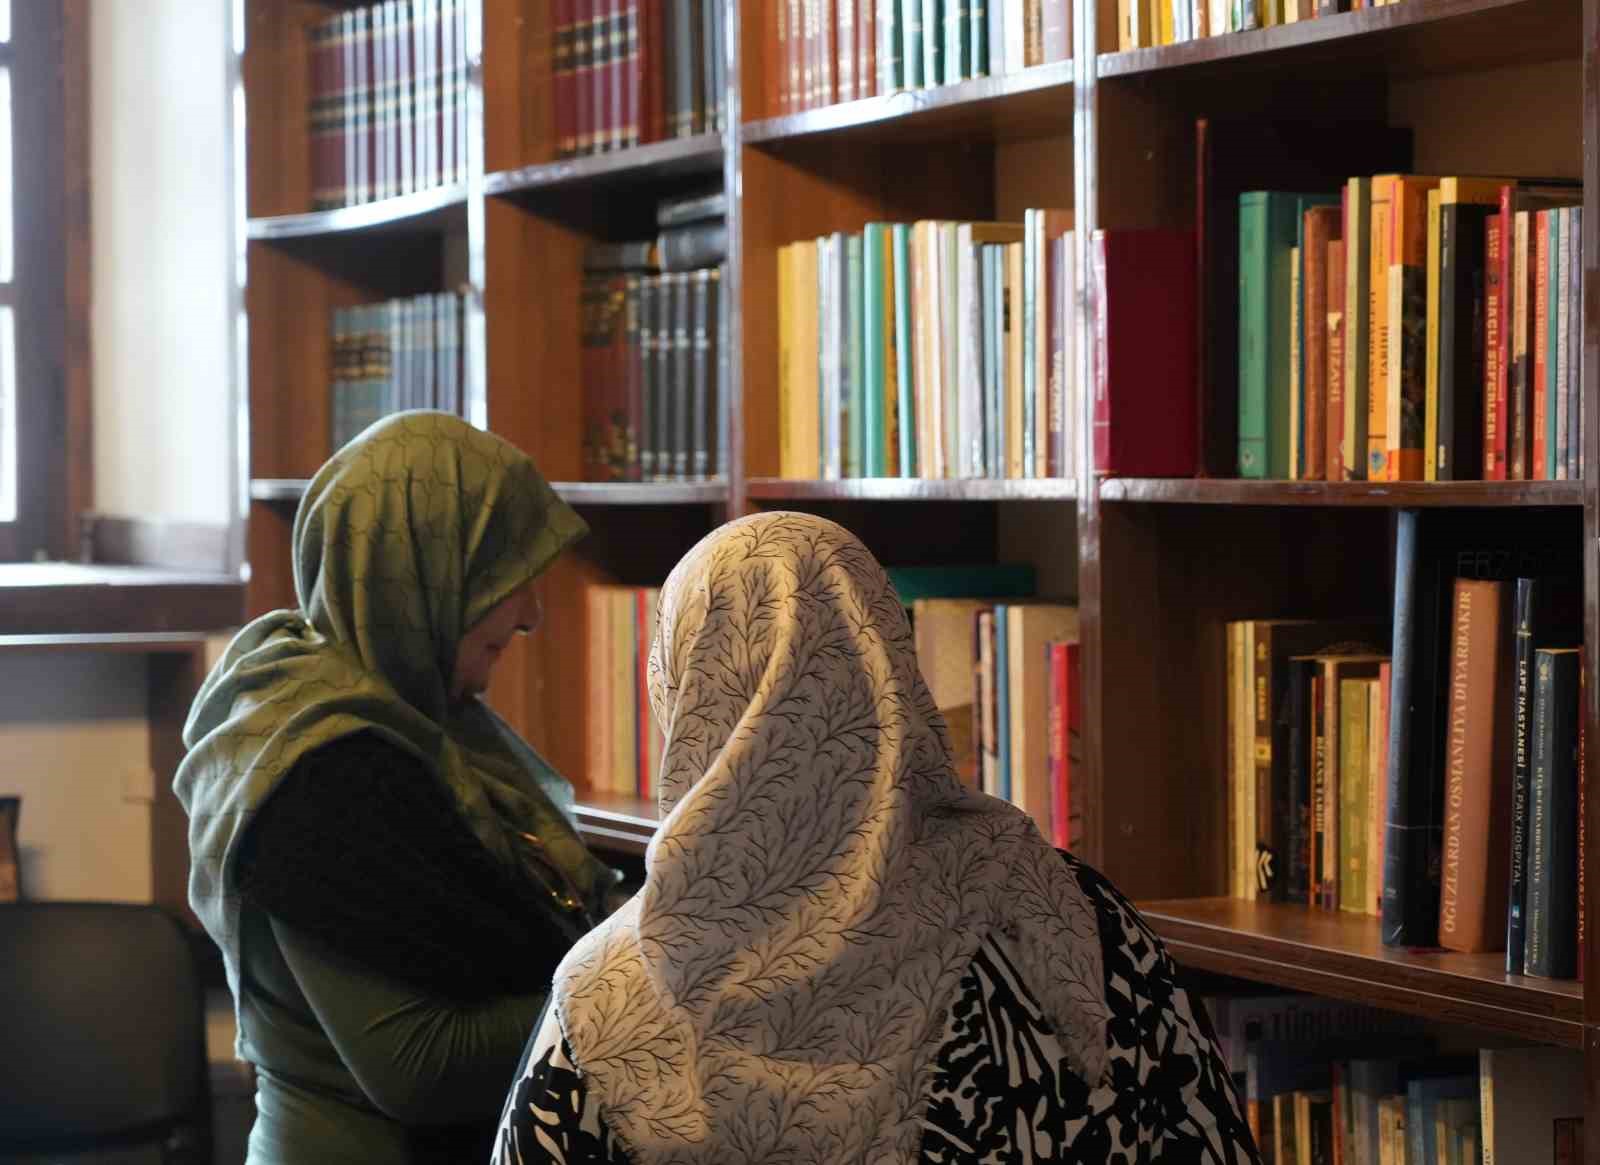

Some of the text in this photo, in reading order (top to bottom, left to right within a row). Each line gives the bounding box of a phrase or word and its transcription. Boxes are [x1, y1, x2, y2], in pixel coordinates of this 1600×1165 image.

[1486, 295, 1498, 345] HAÇLI
[1444, 812, 1461, 933] OĞUZLARDAN
[1454, 590, 1473, 701] DİYARBAKIR
[1511, 659, 1527, 886] LAPE HASTANESİ LA PAIX HOSPITAL
